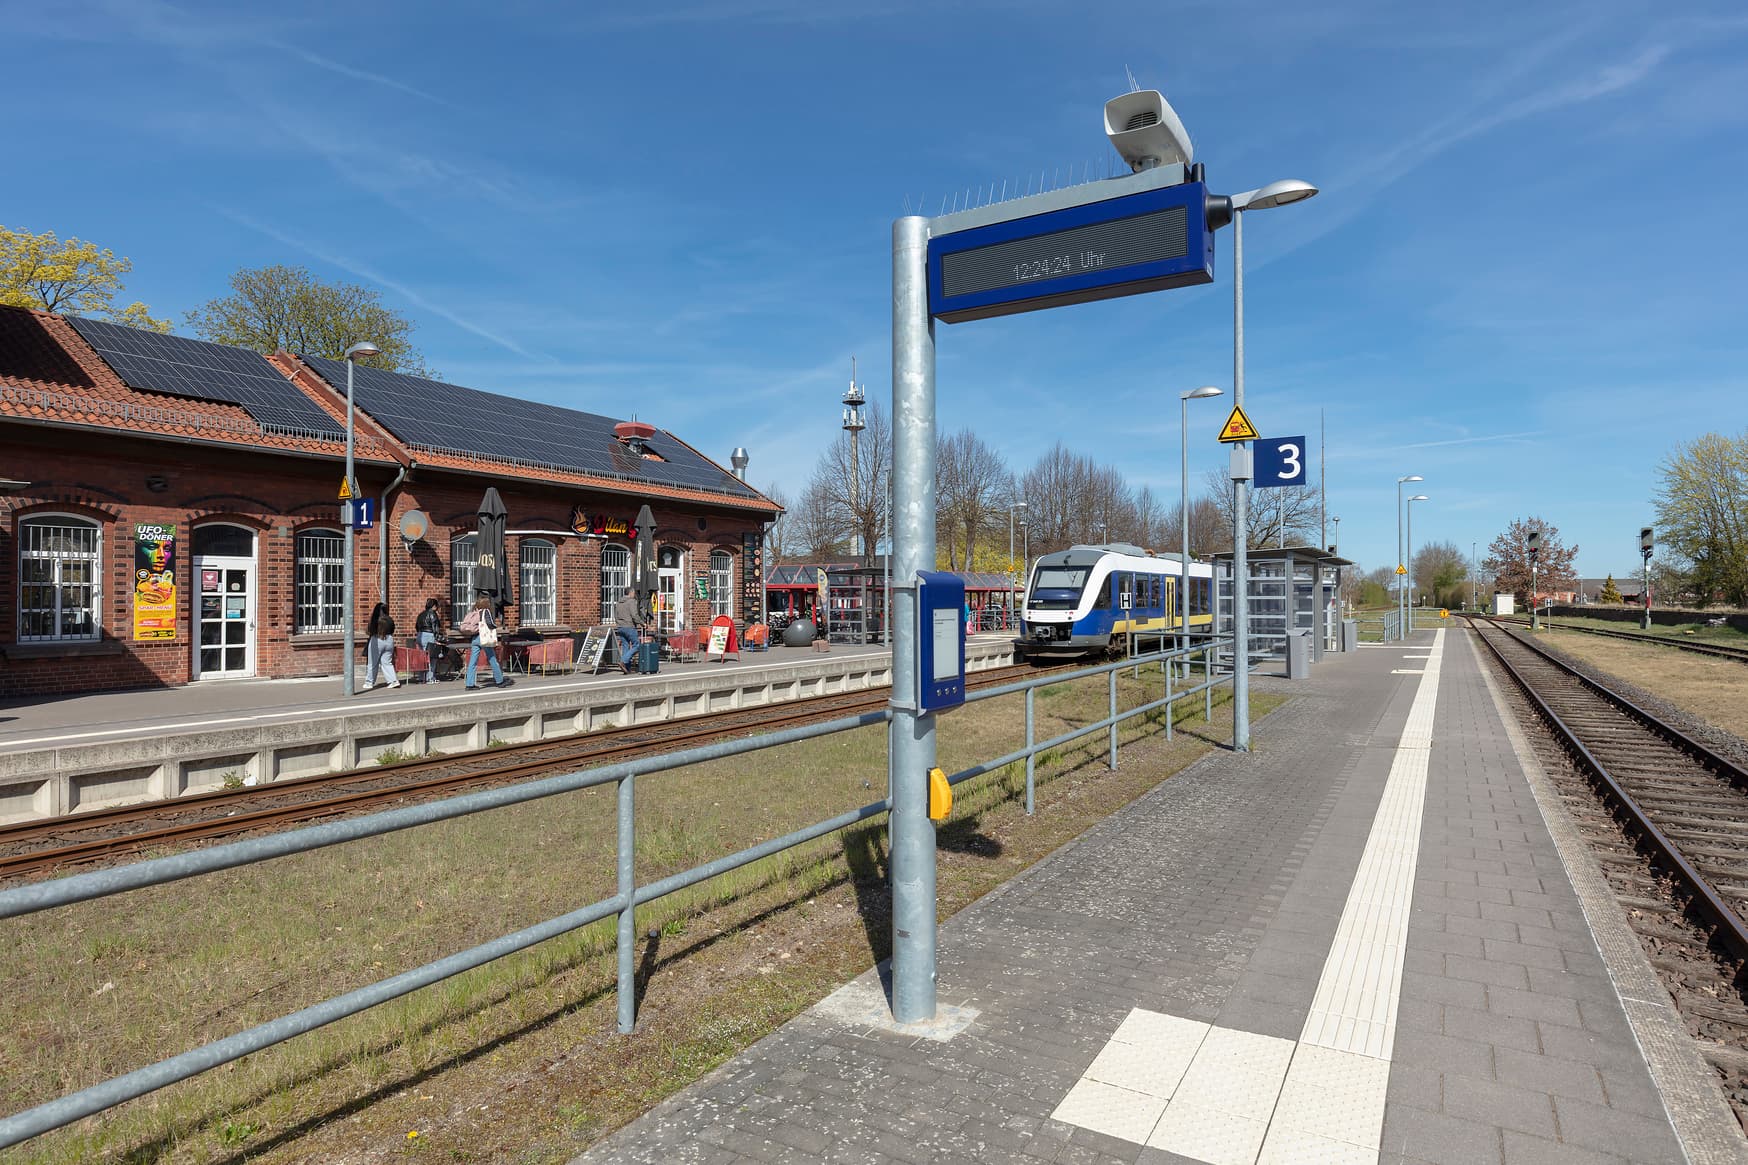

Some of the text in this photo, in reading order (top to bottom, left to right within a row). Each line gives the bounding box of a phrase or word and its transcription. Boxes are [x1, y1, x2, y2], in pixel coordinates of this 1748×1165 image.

[1013, 250, 1106, 280] 12:24:24 Uhr
[1278, 443, 1301, 479] 3
[138, 525, 167, 534] UFO-
[139, 532, 174, 541] DÖNER
[1122, 594, 1130, 608] H
